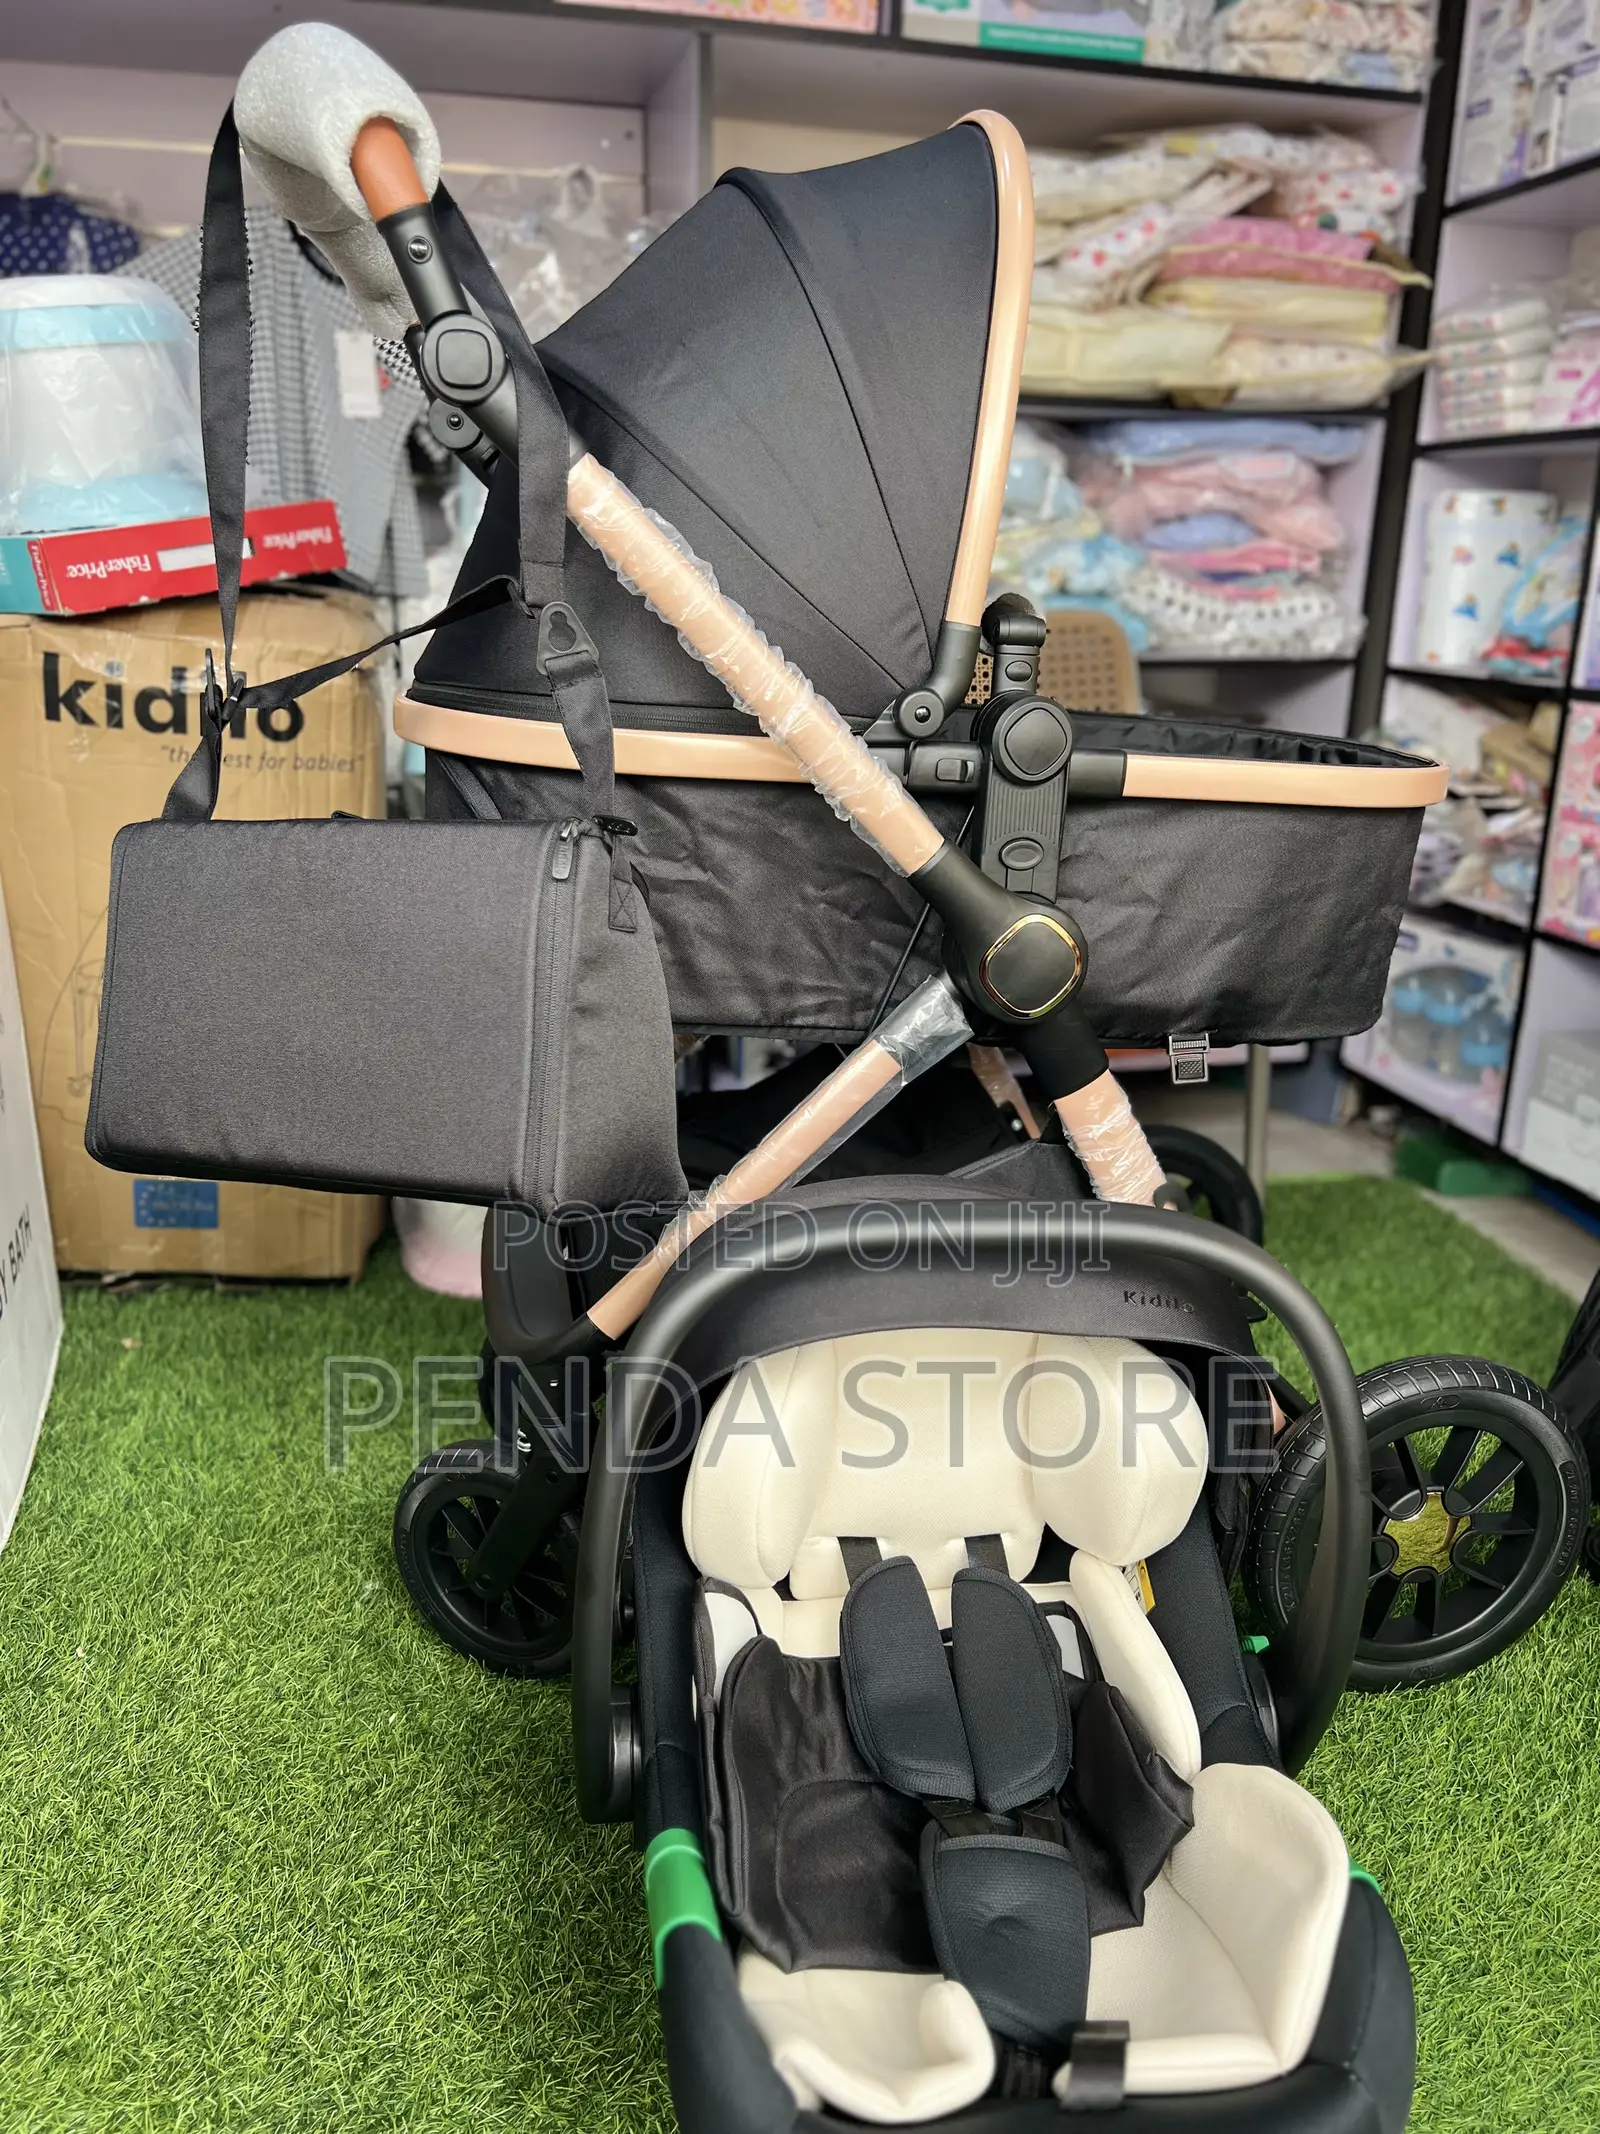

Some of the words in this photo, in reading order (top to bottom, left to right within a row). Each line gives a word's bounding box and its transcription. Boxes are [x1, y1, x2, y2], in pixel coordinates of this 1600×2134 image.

[66, 554, 152, 579] Fisher-Price
[43, 651, 304, 742] kidlo
[256, 751, 286, 778] for
[8, 1202, 32, 1285] BATH
